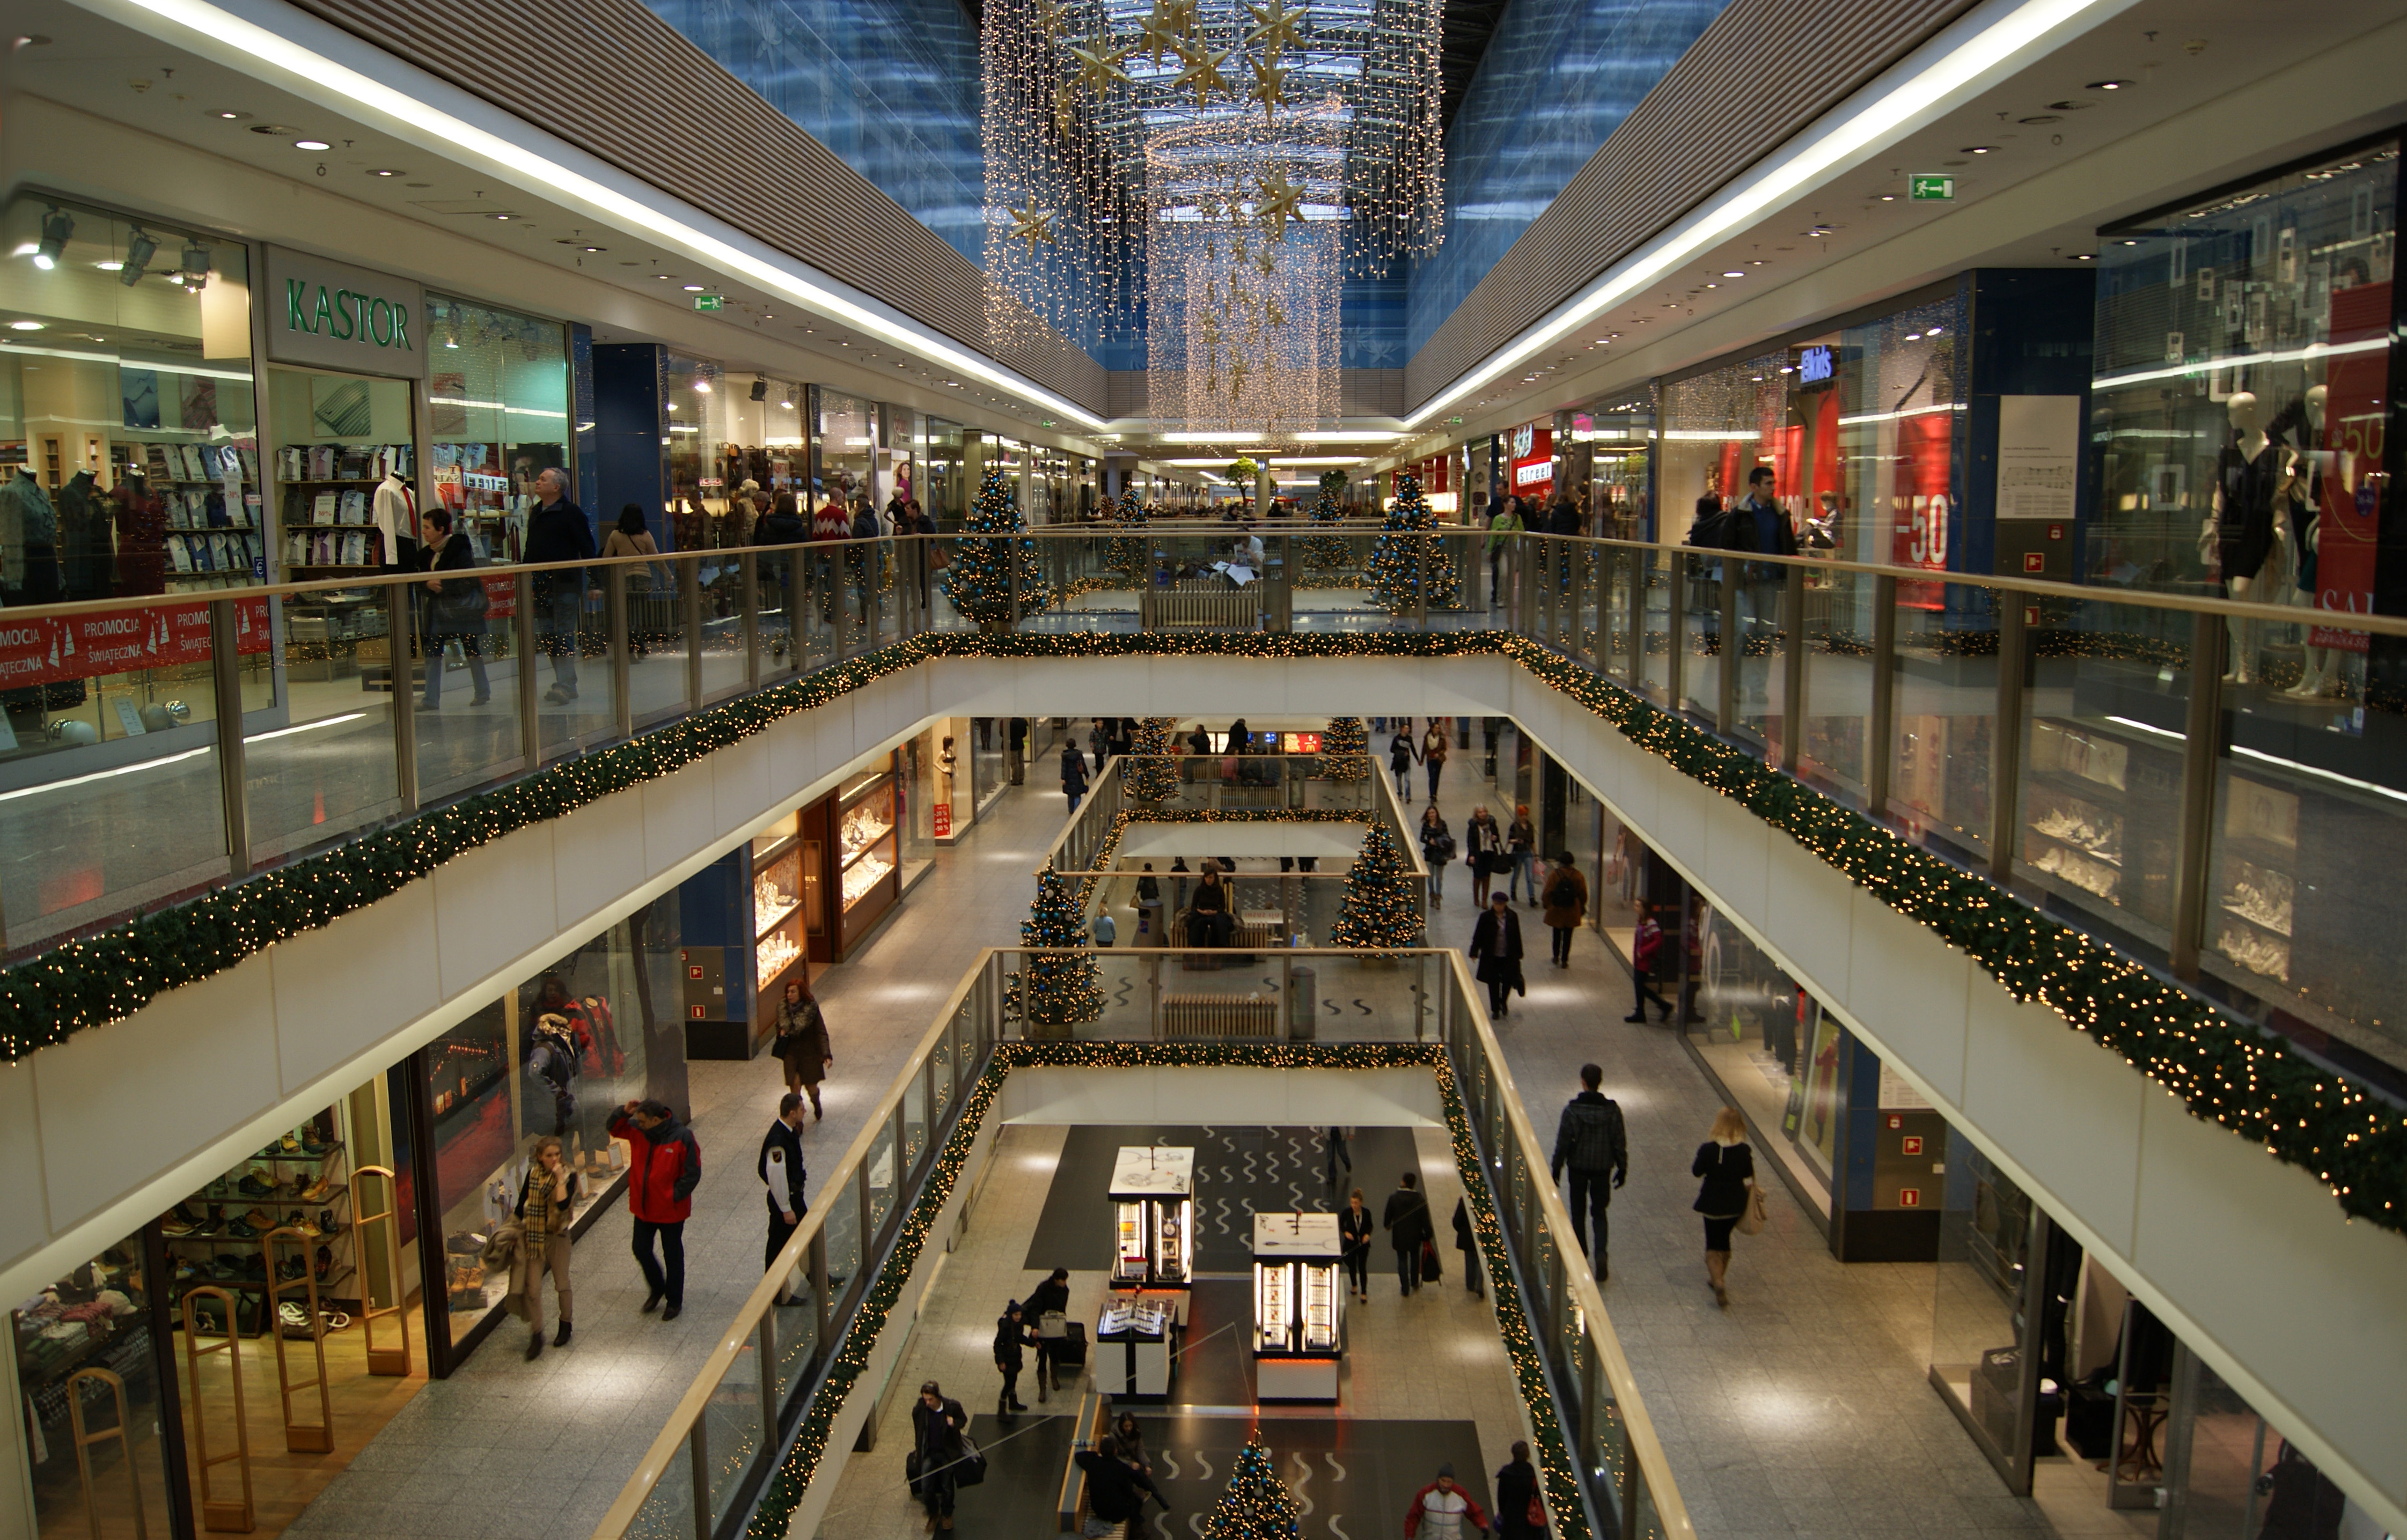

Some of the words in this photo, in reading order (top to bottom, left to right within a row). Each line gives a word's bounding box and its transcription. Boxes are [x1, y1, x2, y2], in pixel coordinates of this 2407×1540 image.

[287, 278, 413, 351] KASTOR
[1520, 465, 1549, 482] street
[84, 618, 141, 637] PROMOCJA
[178, 610, 210, 627] PROMO
[0, 628, 41, 647] MOCJA
